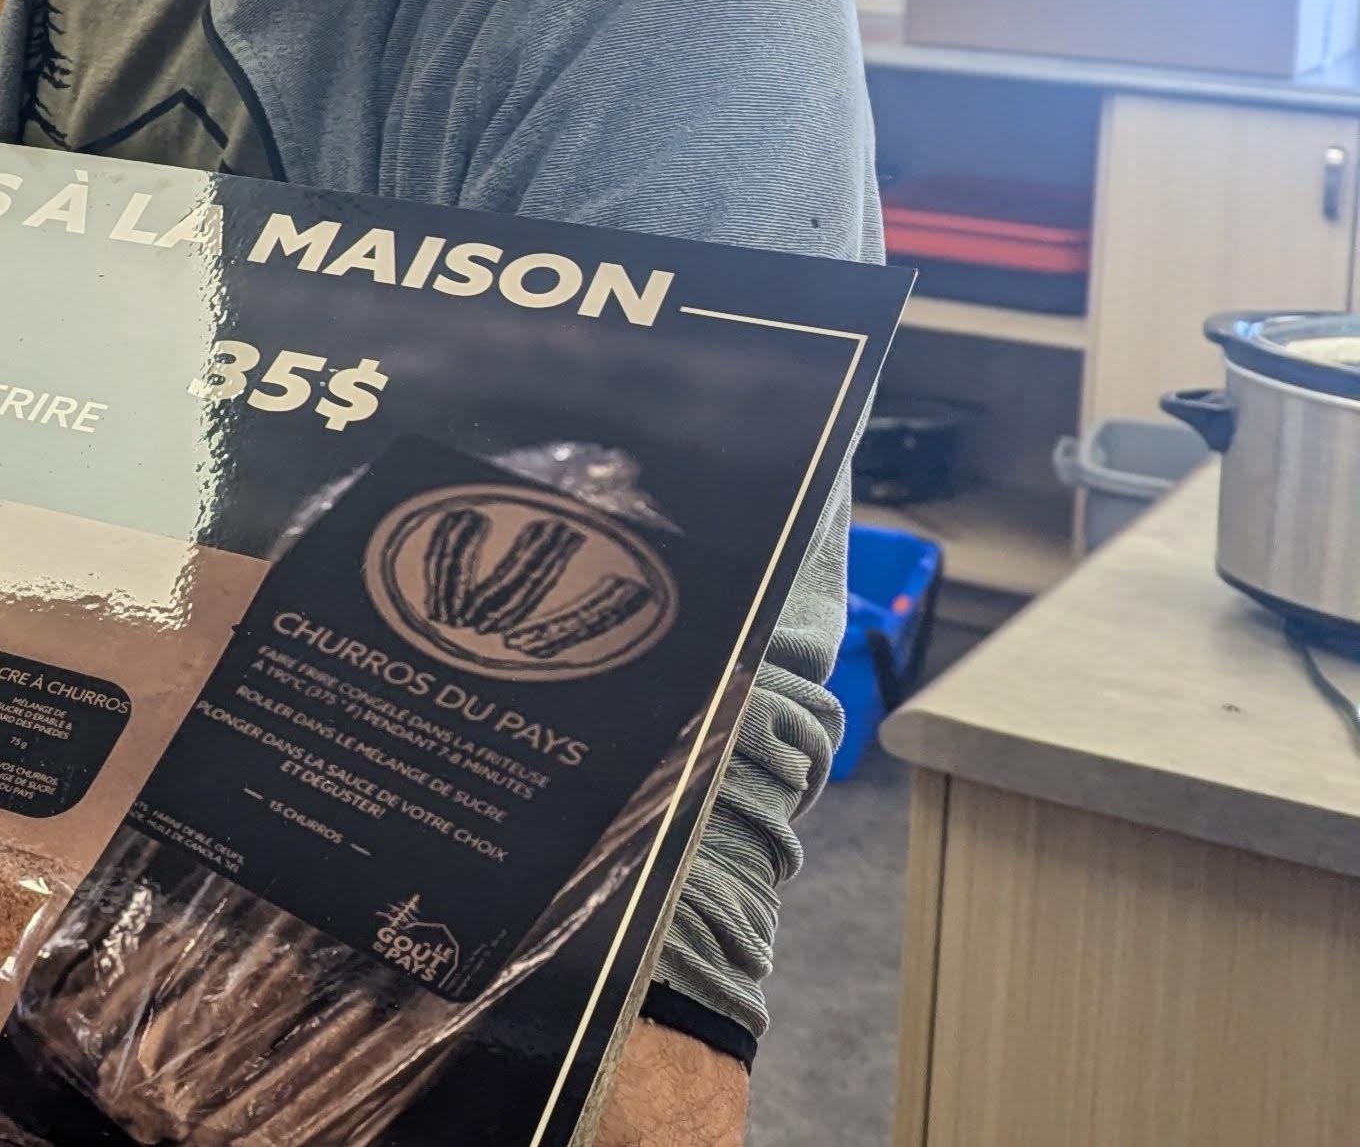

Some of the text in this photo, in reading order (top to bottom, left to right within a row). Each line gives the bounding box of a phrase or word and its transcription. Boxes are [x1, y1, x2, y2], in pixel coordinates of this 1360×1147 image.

[21, 170, 94, 235] À
[109, 188, 224, 255] LA
[247, 212, 675, 328] MAISON
[188, 340, 389, 432] 35$
[30, 673, 45, 691] À
[47, 681, 131, 714] CHURROS
[272, 612, 589, 766] CHURROS DU PAYS
[15, 718, 33, 730] DES
[53, 707, 67, 718] DE
[236, 684, 294, 718] ROULER
[292, 713, 337, 739] DANS
[335, 733, 357, 749] LE
[429, 777, 454, 797] DE
[454, 789, 508, 824] SUCRE
[407, 715, 454, 742] DANS
[453, 737, 475, 752] LA
[196, 700, 509, 862] PLONGER DANS LA SAUCE DE VOTRE CHOIX
[280, 760, 303, 776] ET
[462, 757, 535, 799] MINUTES
[283, 807, 344, 845] CHURROS
[384, 946, 437, 982] PAYS
